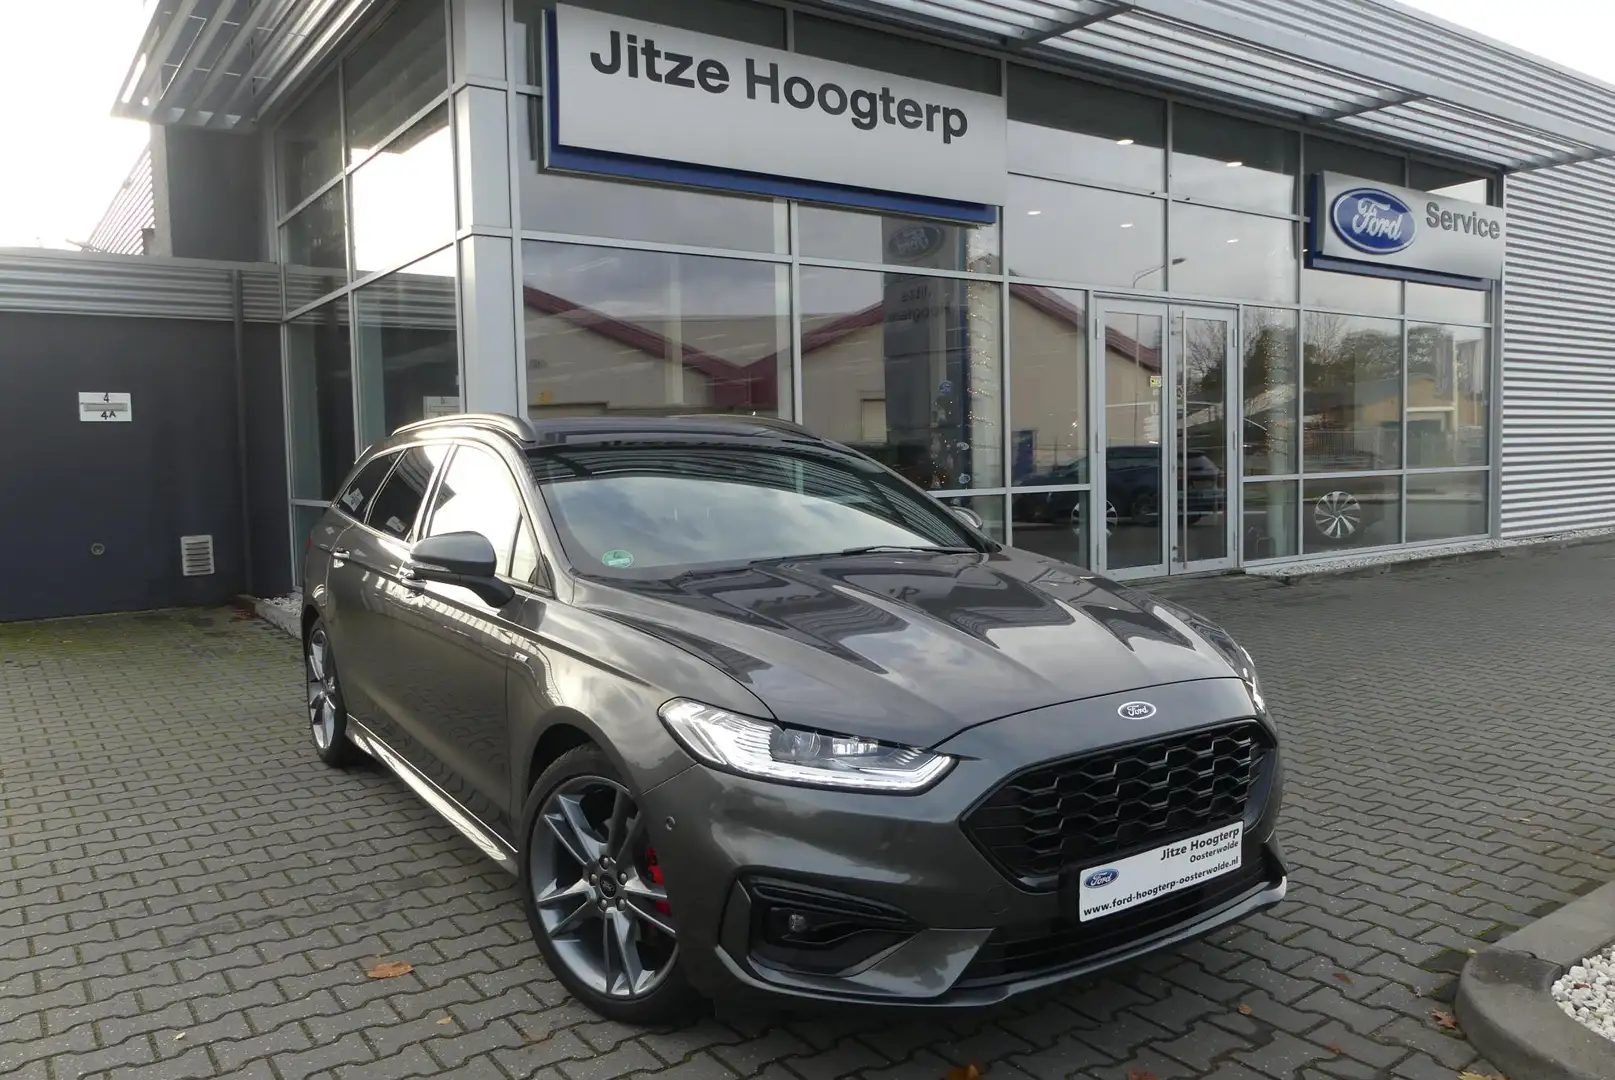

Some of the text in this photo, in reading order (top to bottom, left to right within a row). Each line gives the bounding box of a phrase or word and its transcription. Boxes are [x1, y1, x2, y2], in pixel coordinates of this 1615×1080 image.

[590, 30, 968, 144] Jitze Hoogterp
[1352, 198, 1402, 240] Ford
[1426, 202, 1500, 239] Service
[103, 393, 110, 403] 4
[101, 411, 116, 420] 4A
[1127, 704, 1148, 716] Ford
[1161, 828, 1239, 860] Jitze Hoogterp
[1189, 840, 1238, 862] Oosterwolde
[1083, 856, 1238, 916] www.ford-hoogterp-oosterwolde.nl
[1090, 871, 1112, 886] Ford
